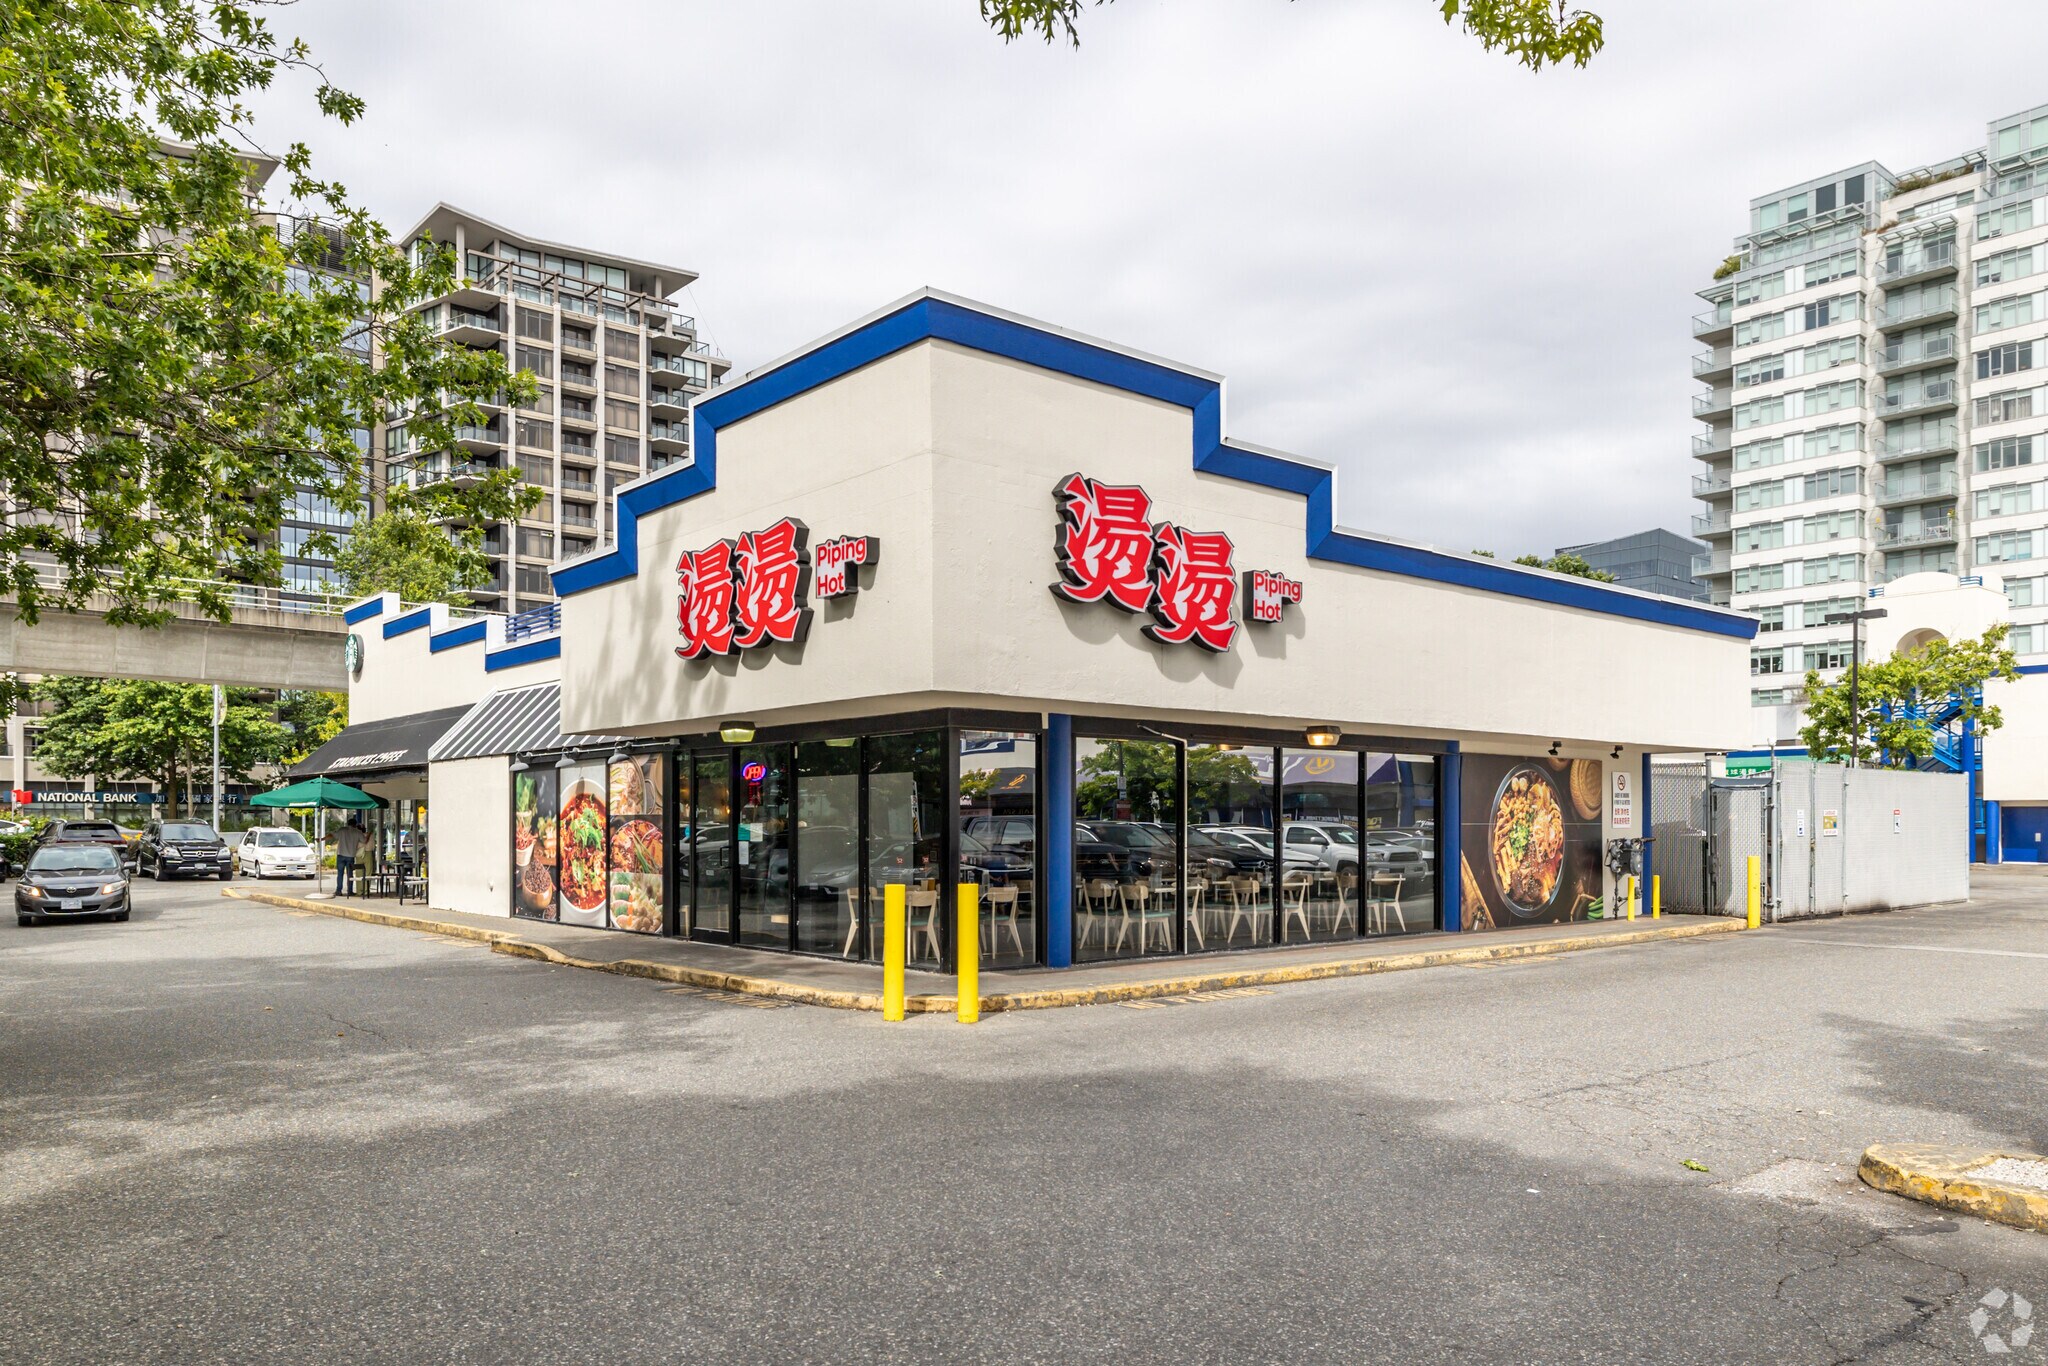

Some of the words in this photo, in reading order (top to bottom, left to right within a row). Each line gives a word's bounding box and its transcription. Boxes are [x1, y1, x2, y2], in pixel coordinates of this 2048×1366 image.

[816, 537, 867, 568] Piping
[816, 572, 845, 596] Hot
[1253, 572, 1301, 601] Piping
[1253, 599, 1282, 621] Hot
[37, 792, 99, 803] NATIONAL
[103, 793, 137, 803] BANK
